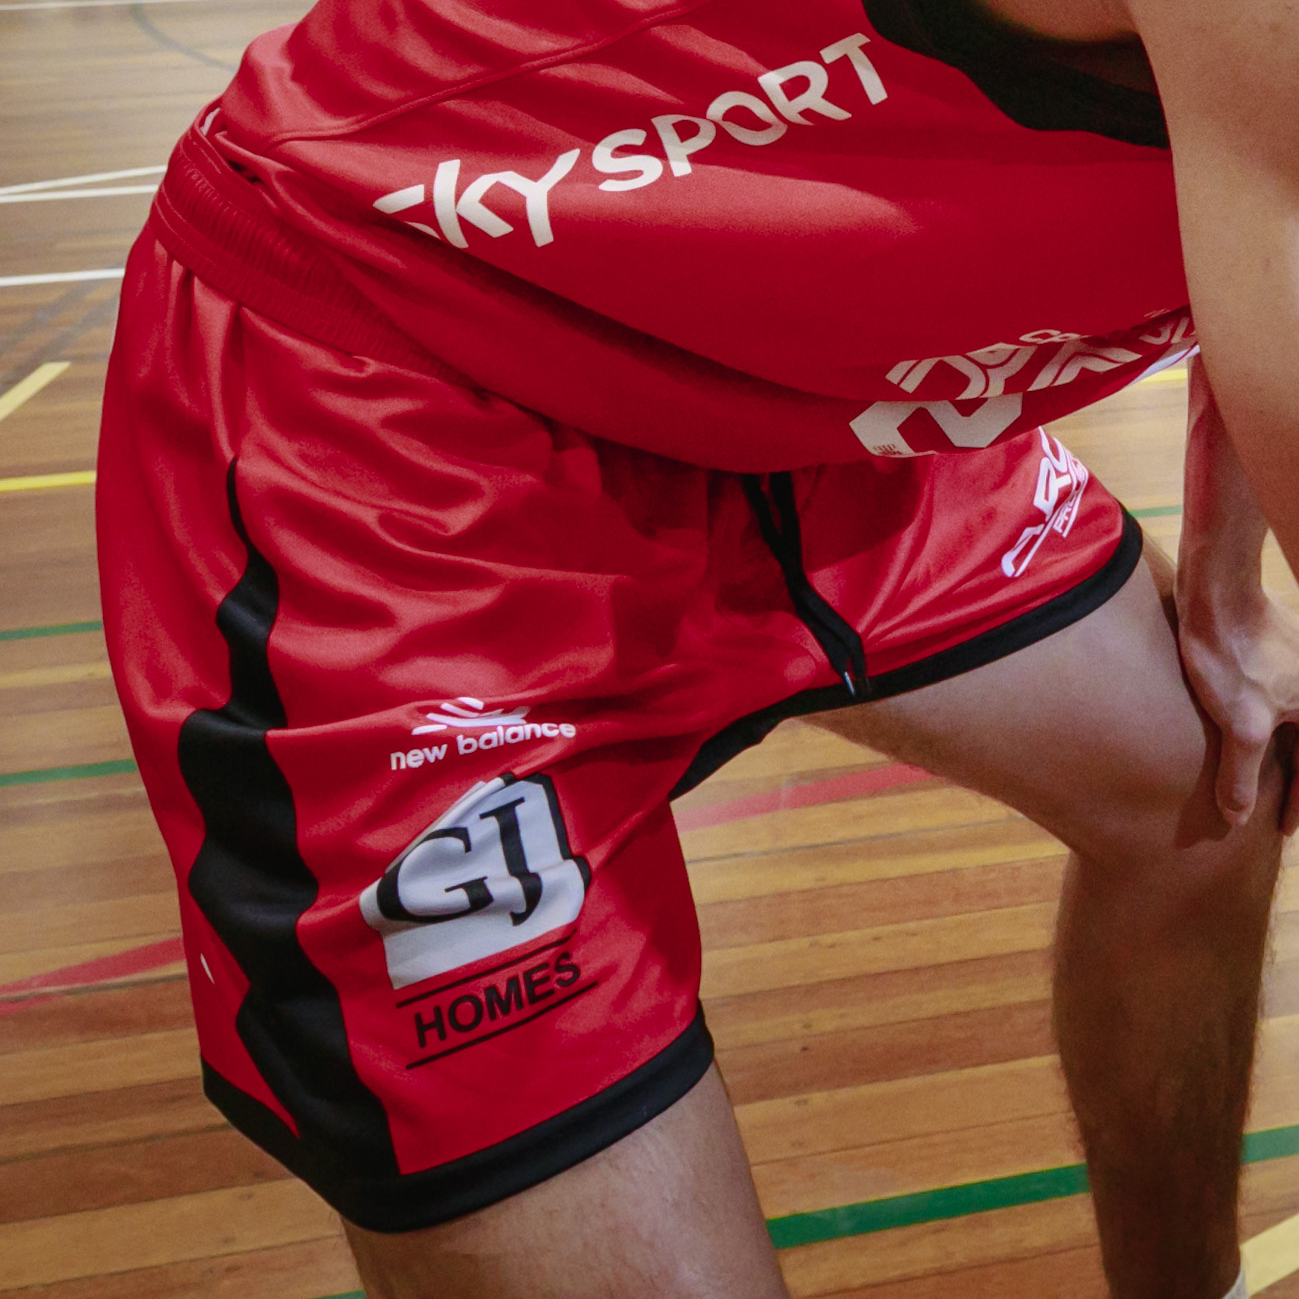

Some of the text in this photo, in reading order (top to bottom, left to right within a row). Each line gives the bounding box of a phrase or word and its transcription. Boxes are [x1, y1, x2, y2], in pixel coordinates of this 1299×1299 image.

[591, 32, 888, 192] SPORT
[390, 720, 577, 771] new balance
[376, 796, 543, 928] GJ
[412, 950, 582, 1049] HOMES
